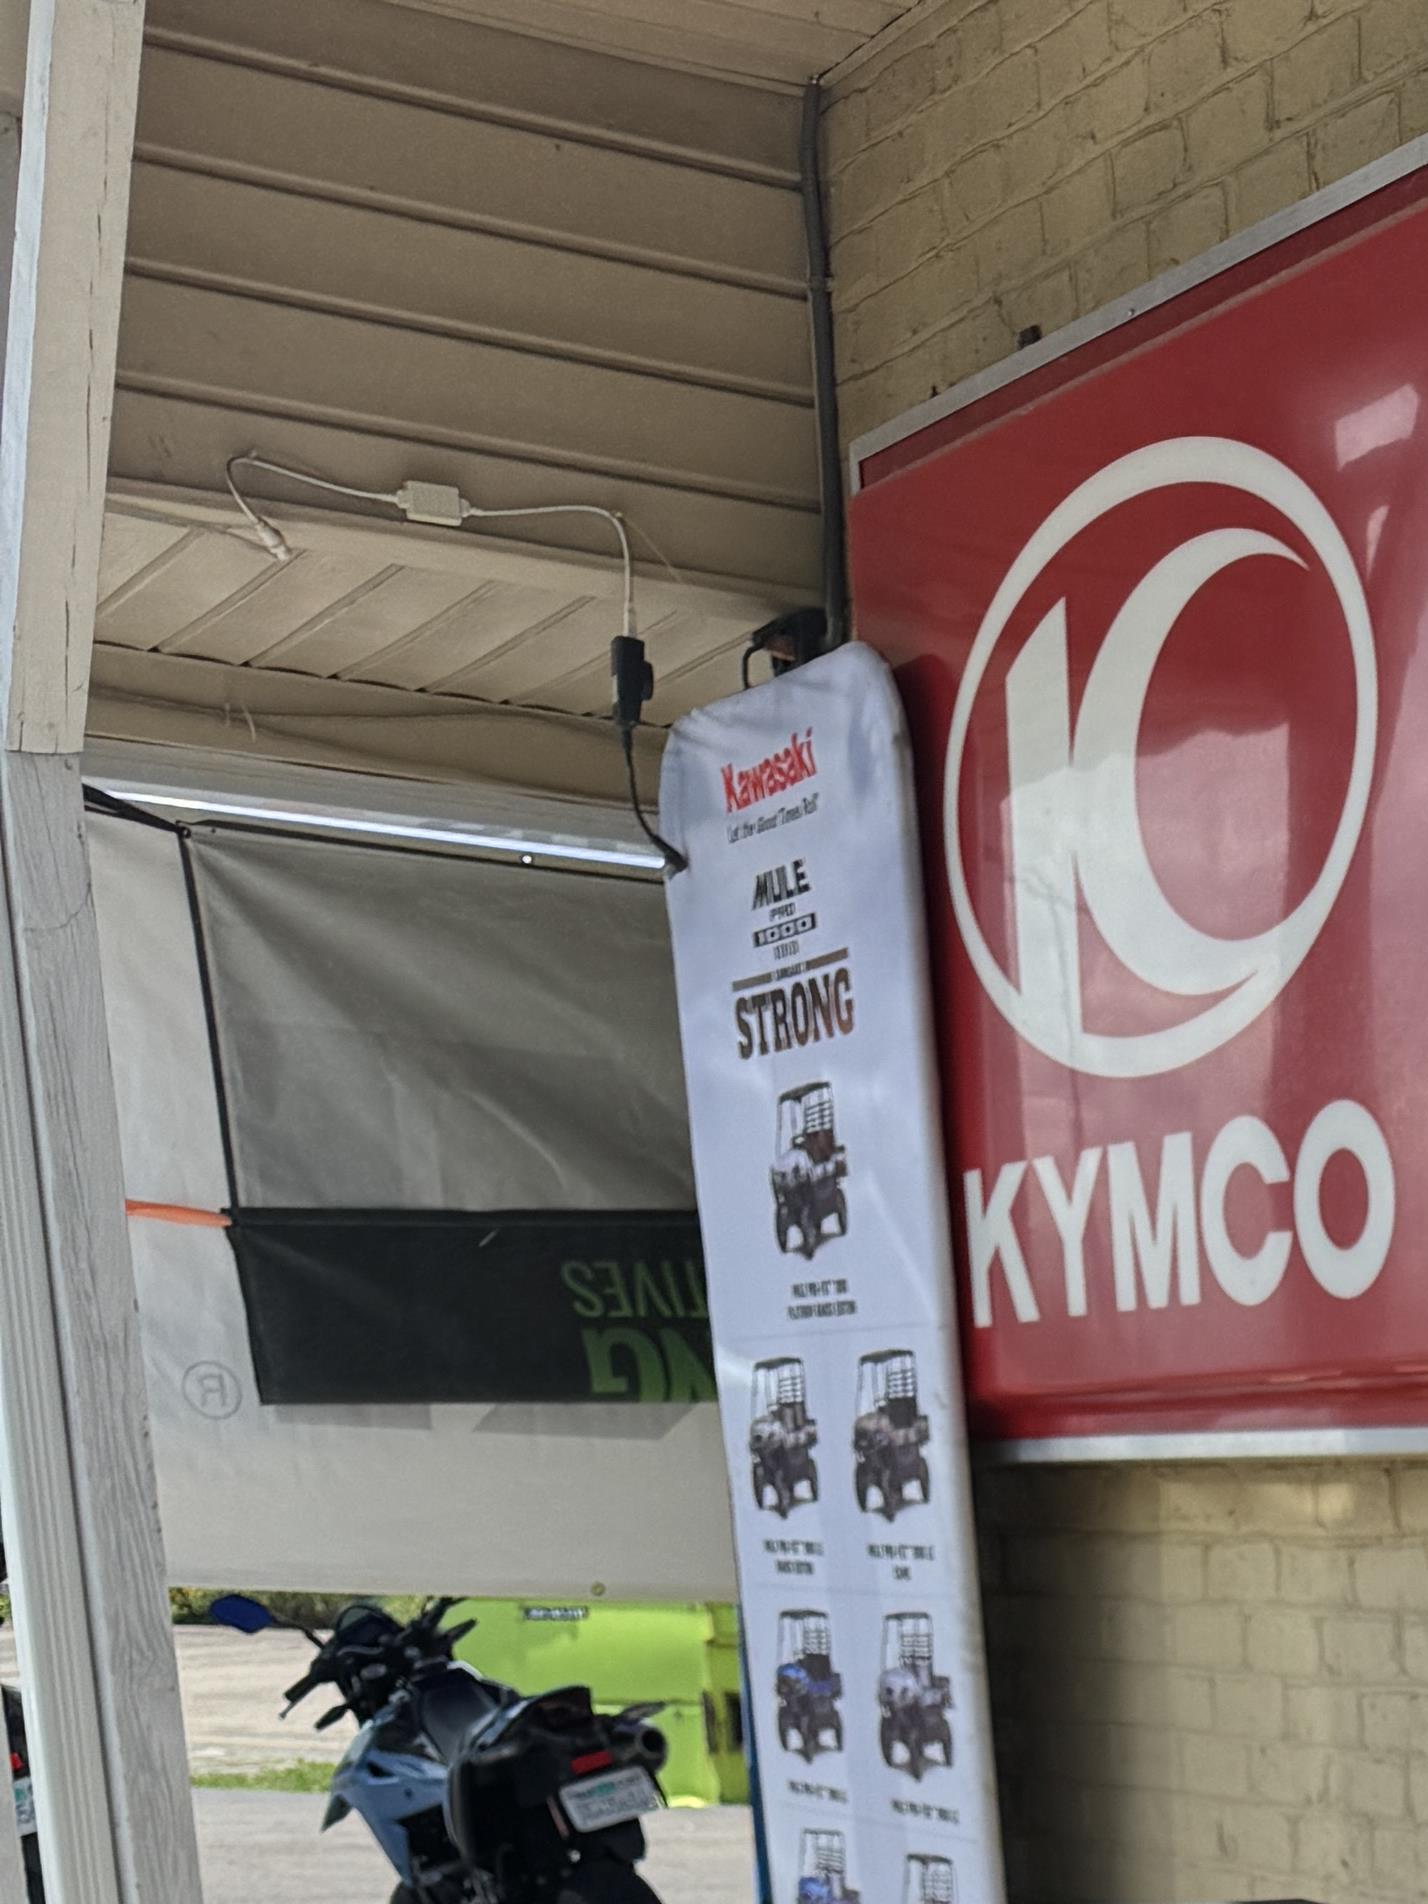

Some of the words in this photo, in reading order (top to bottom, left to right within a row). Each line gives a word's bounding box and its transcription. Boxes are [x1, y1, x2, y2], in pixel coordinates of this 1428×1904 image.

[721, 726, 816, 814] Kawasaki
[752, 858, 811, 911] MULE
[757, 914, 814, 945] 1000
[735, 967, 854, 1061] STRONG
[962, 1098, 1396, 1330] KYMCO
